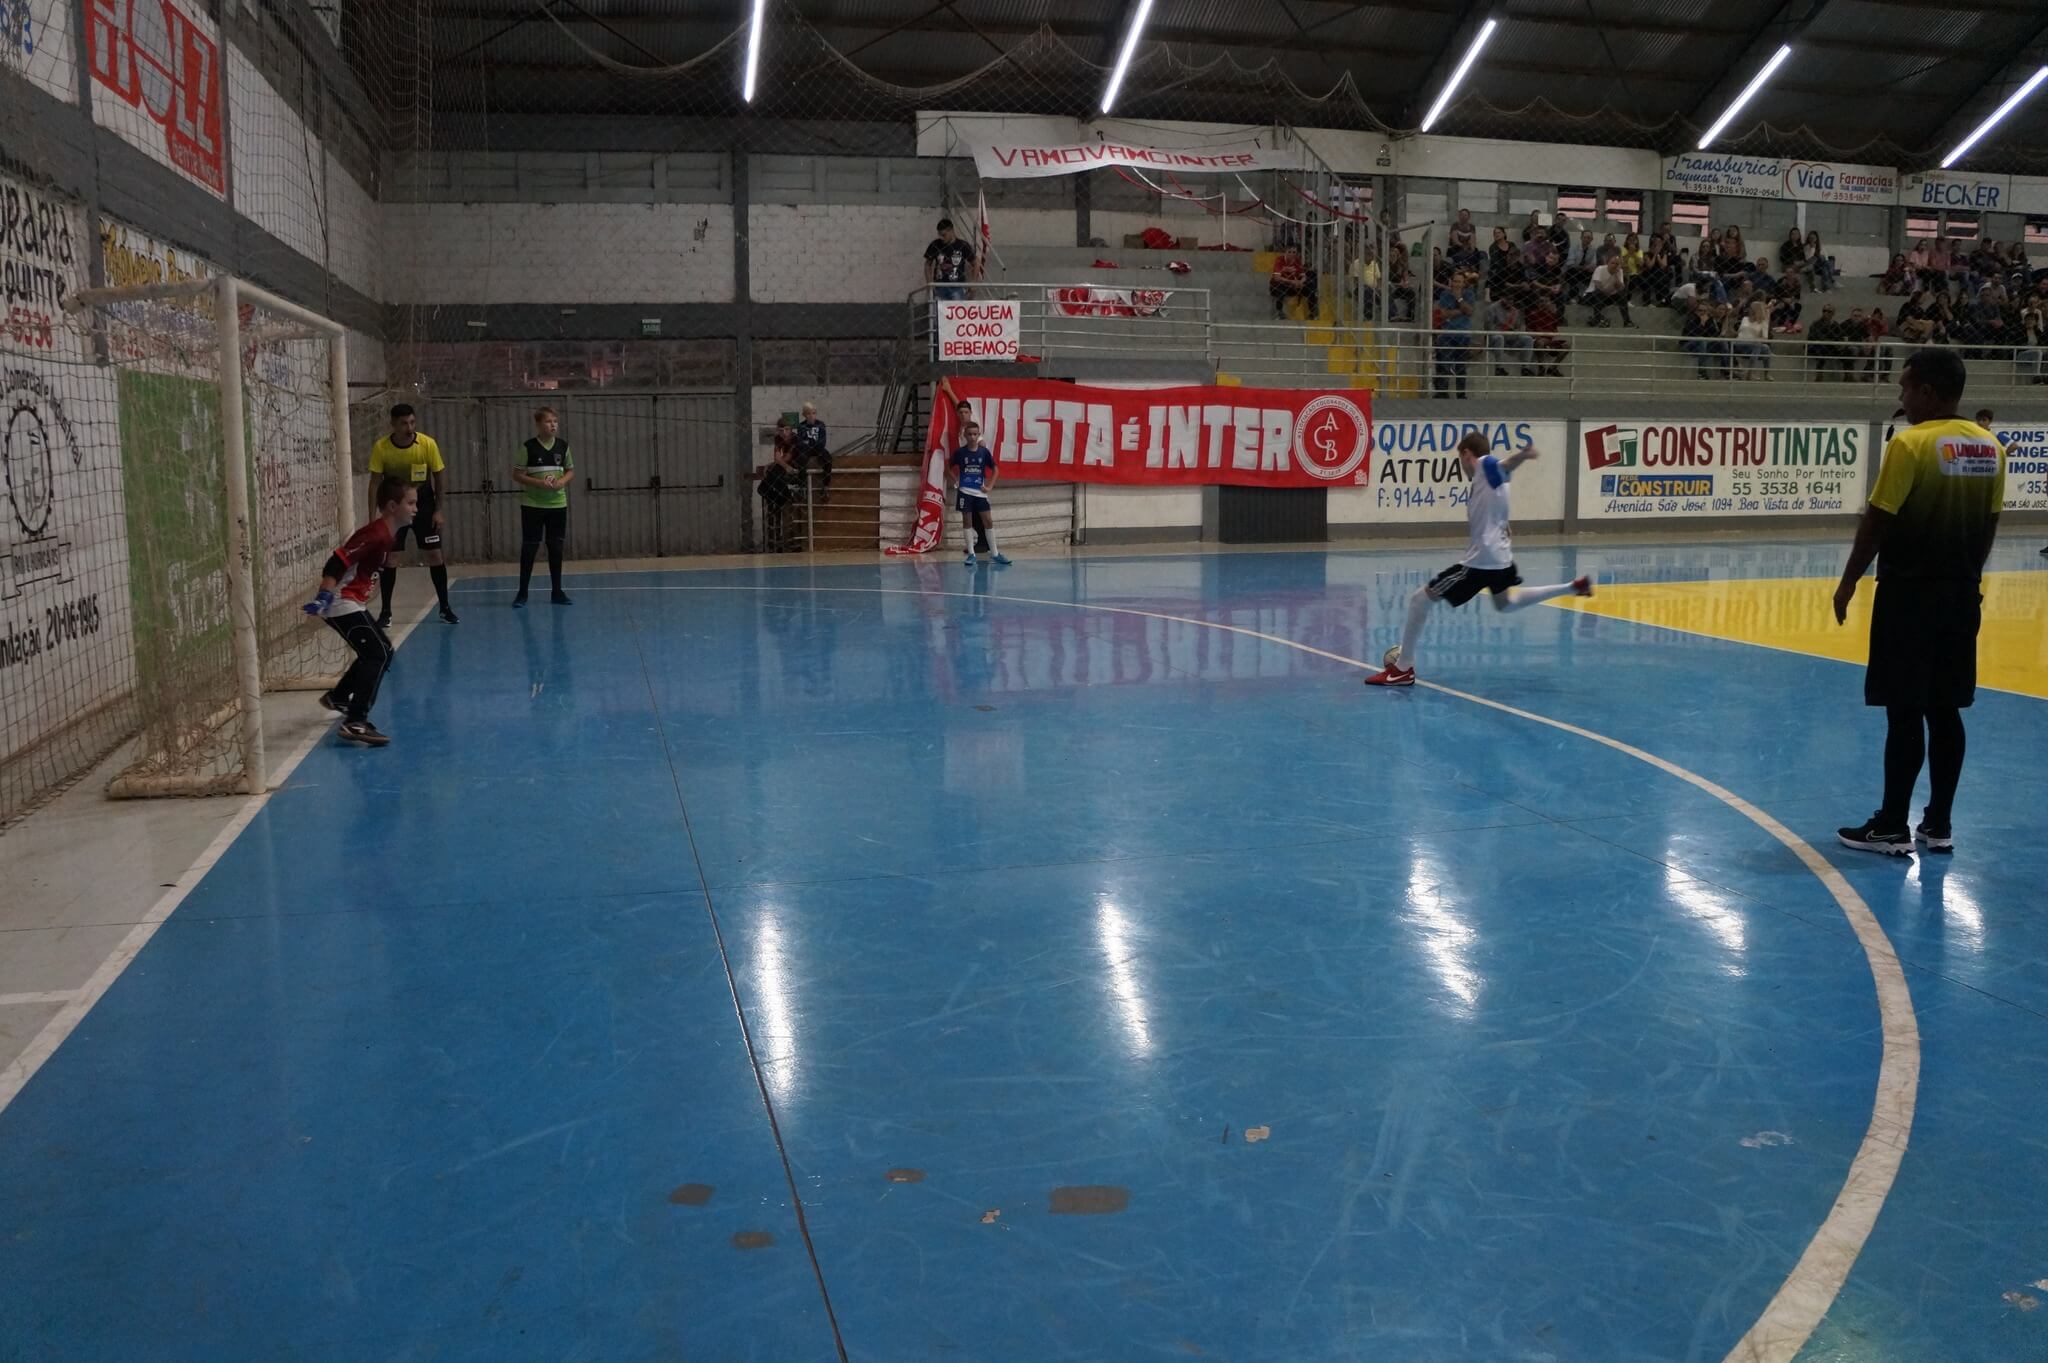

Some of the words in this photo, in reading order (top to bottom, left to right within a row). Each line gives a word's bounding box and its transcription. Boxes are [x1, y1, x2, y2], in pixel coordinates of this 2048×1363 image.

[1797, 170, 1835, 190] Vida
[1840, 173, 1893, 187] Farmácias
[1921, 182, 2000, 208] BECKER
[945, 305, 1013, 320] JOGUEM
[956, 323, 1003, 337] COMO
[944, 340, 1018, 356] BEBEMOS
[1121, 417, 1140, 451] É
[1146, 405, 1294, 471] INTER
[1371, 422, 1533, 456] QUADIAS
[1642, 426, 1858, 467] CONSTRUTINTAS
[1380, 458, 1473, 484] ATTUA
[1732, 469, 1750, 479] Seu
[1757, 469, 1789, 479] Sonho
[1796, 469, 1814, 479] Por
[1820, 469, 1856, 479] Inteiro
[1394, 487, 1474, 508] 9144-54
[1618, 480, 1711, 497] CONSTRUIR
[1732, 482, 1751, 495] 55
[1760, 482, 1798, 495] 3538
[1805, 482, 1841, 494] 1641
[1605, 499, 1653, 513] Avenida
[1711, 498, 1733, 511] 1094
[1738, 498, 1759, 510] Boa
[1762, 498, 1788, 510] Vista
[1791, 498, 1804, 510] do
[0, 617, 41, 669] ndação
